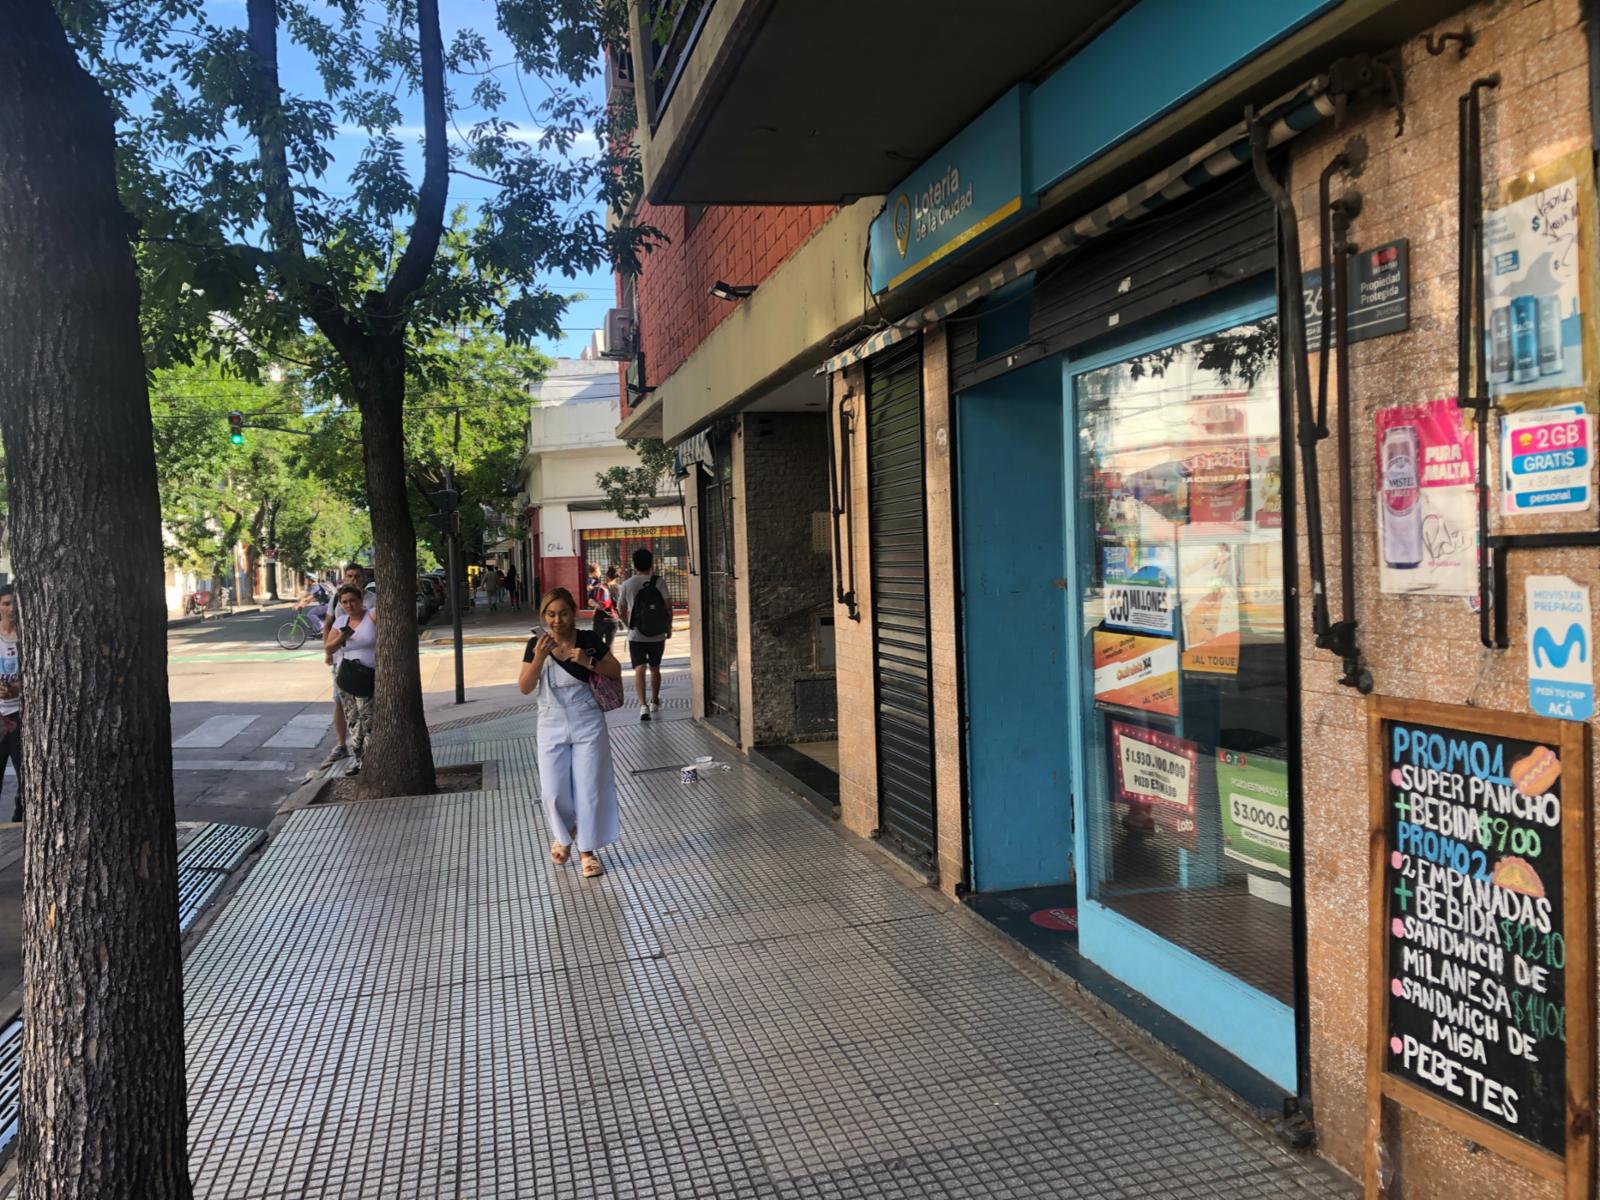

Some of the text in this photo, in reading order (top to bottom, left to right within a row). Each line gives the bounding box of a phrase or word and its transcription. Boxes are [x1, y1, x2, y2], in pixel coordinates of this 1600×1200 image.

[915, 219, 927, 243] de
[938, 181, 973, 225] Ciudad
[1361, 270, 1400, 293] Propiedad
[1361, 286, 1399, 304] Protegida
[1425, 445, 1462, 463] PURA
[1523, 451, 1575, 472] GRATIS
[1424, 461, 1470, 481] MALTA
[1529, 488, 1571, 505] personal
[1130, 589, 1168, 613] MILLONES
[1534, 589, 1582, 600] MOVISTAR
[1534, 601, 1583, 613] PREPAGO
[1548, 700, 1574, 716] ACÁ
[1401, 764, 1560, 827] SUPER PANCHO
[1479, 810, 1542, 857] $900
[1402, 855, 1552, 934] 2 EMPANADAS
[1404, 916, 1549, 993] SANDWICH DE
[1501, 920, 1567, 969] $1210
[1507, 1026, 1539, 1062] DE
[1403, 1034, 1519, 1124] PEBETES
